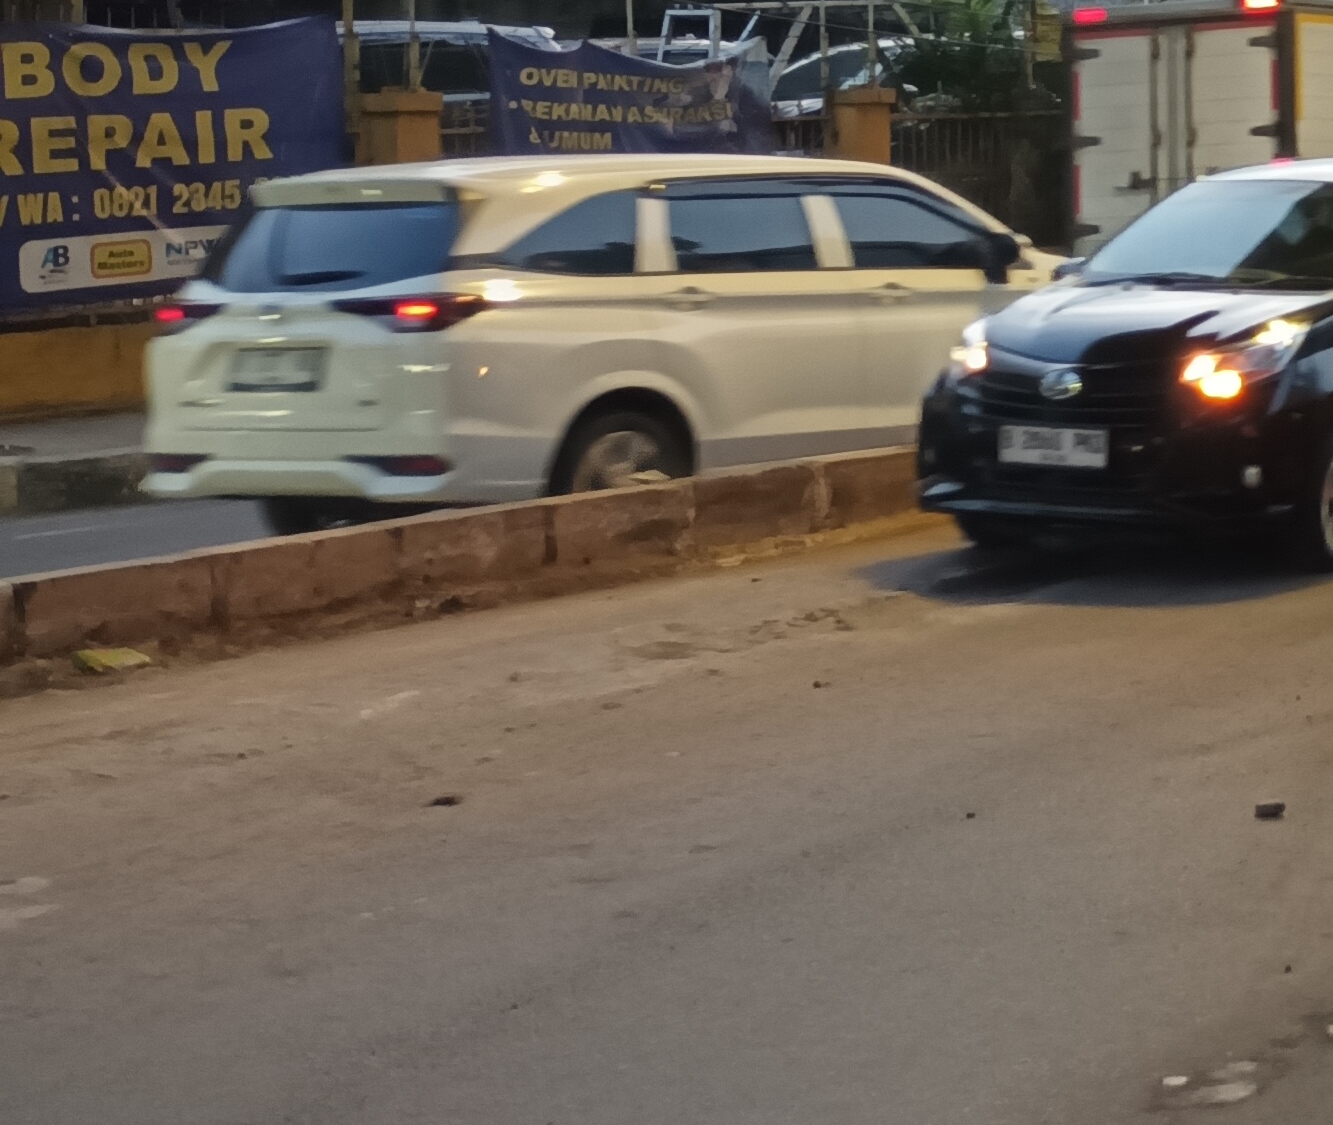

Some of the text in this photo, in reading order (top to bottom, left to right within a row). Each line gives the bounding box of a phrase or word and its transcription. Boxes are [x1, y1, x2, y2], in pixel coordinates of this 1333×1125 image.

[2, 40, 233, 99] BODY
[17, 191, 64, 226] WA
[93, 184, 159, 219] 0821
[172, 178, 242, 214] 2345
